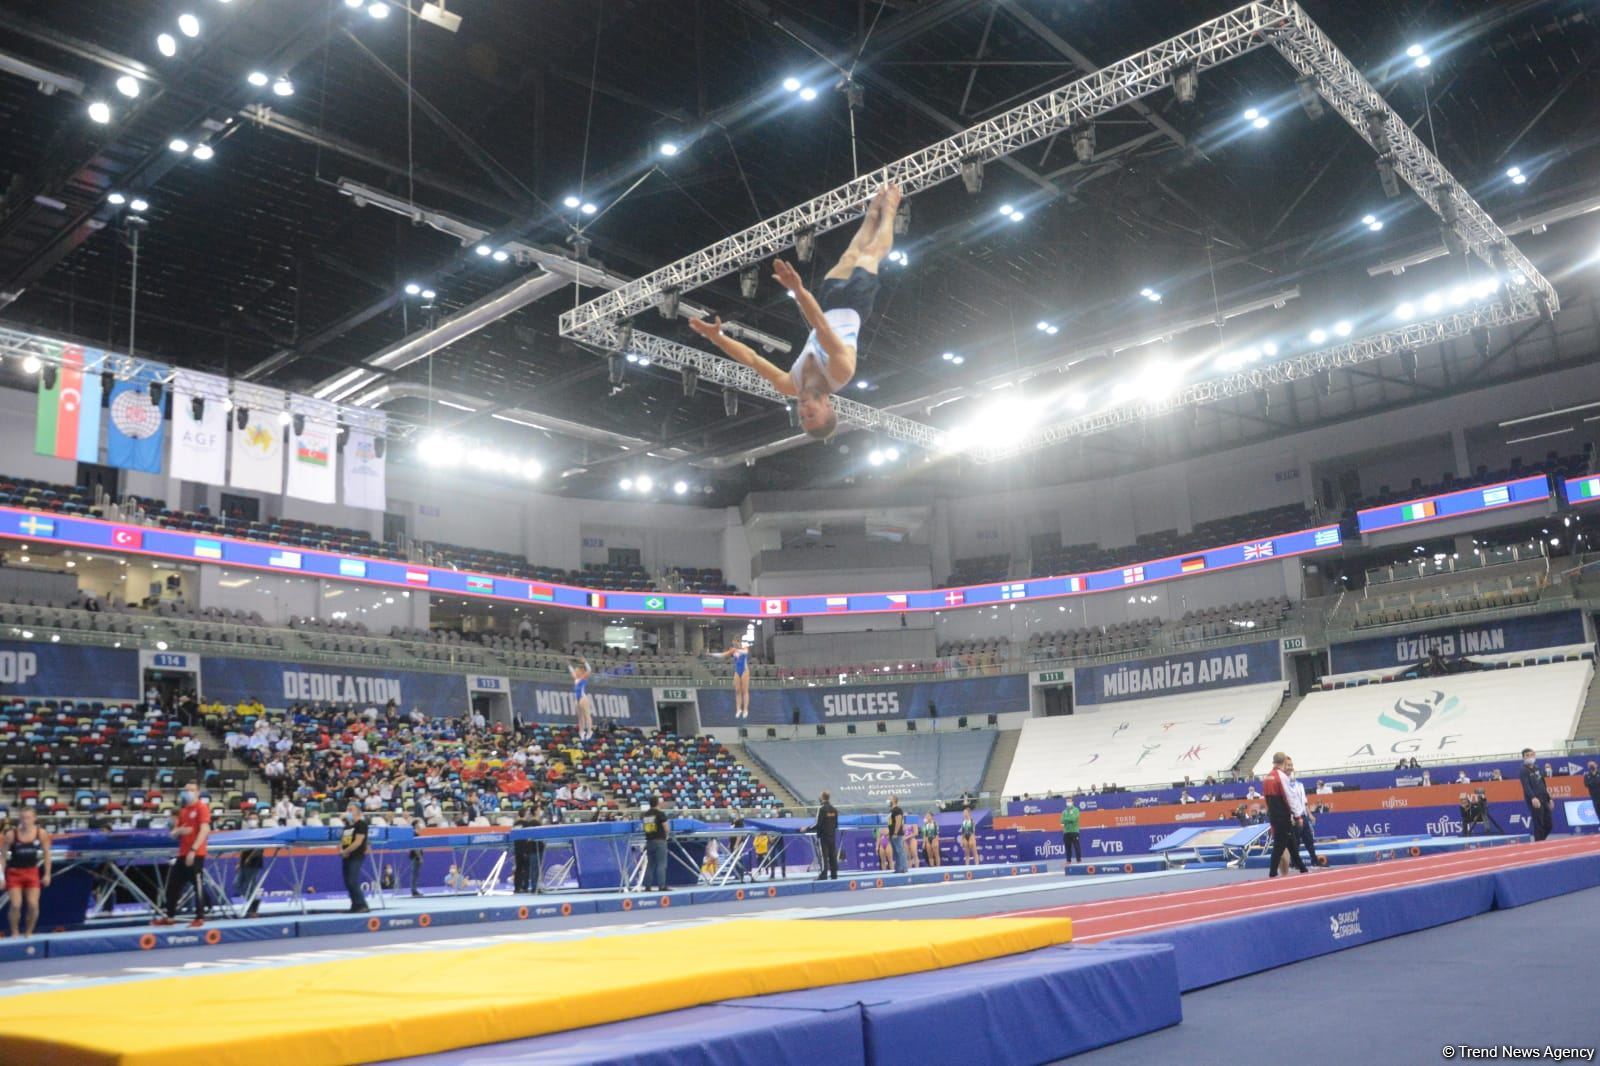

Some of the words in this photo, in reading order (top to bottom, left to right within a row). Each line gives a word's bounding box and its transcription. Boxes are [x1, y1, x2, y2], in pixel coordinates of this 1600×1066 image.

[1285, 639, 1301, 649] 110
[1460, 628, 1505, 653] İNAN
[160, 654, 180, 666] 114
[1198, 653, 1249, 683] APAR
[1045, 672, 1059, 681] 111
[283, 671, 402, 705] DEDICATION
[481, 678, 497, 689] 113
[668, 690, 683, 699] 112
[535, 689, 631, 719] MOTIATION
[823, 692, 900, 717] SUCCESS
[847, 770, 919, 782] MGA
[1364, 822, 1391, 834] AGF
[1101, 840, 1124, 854] VTB
